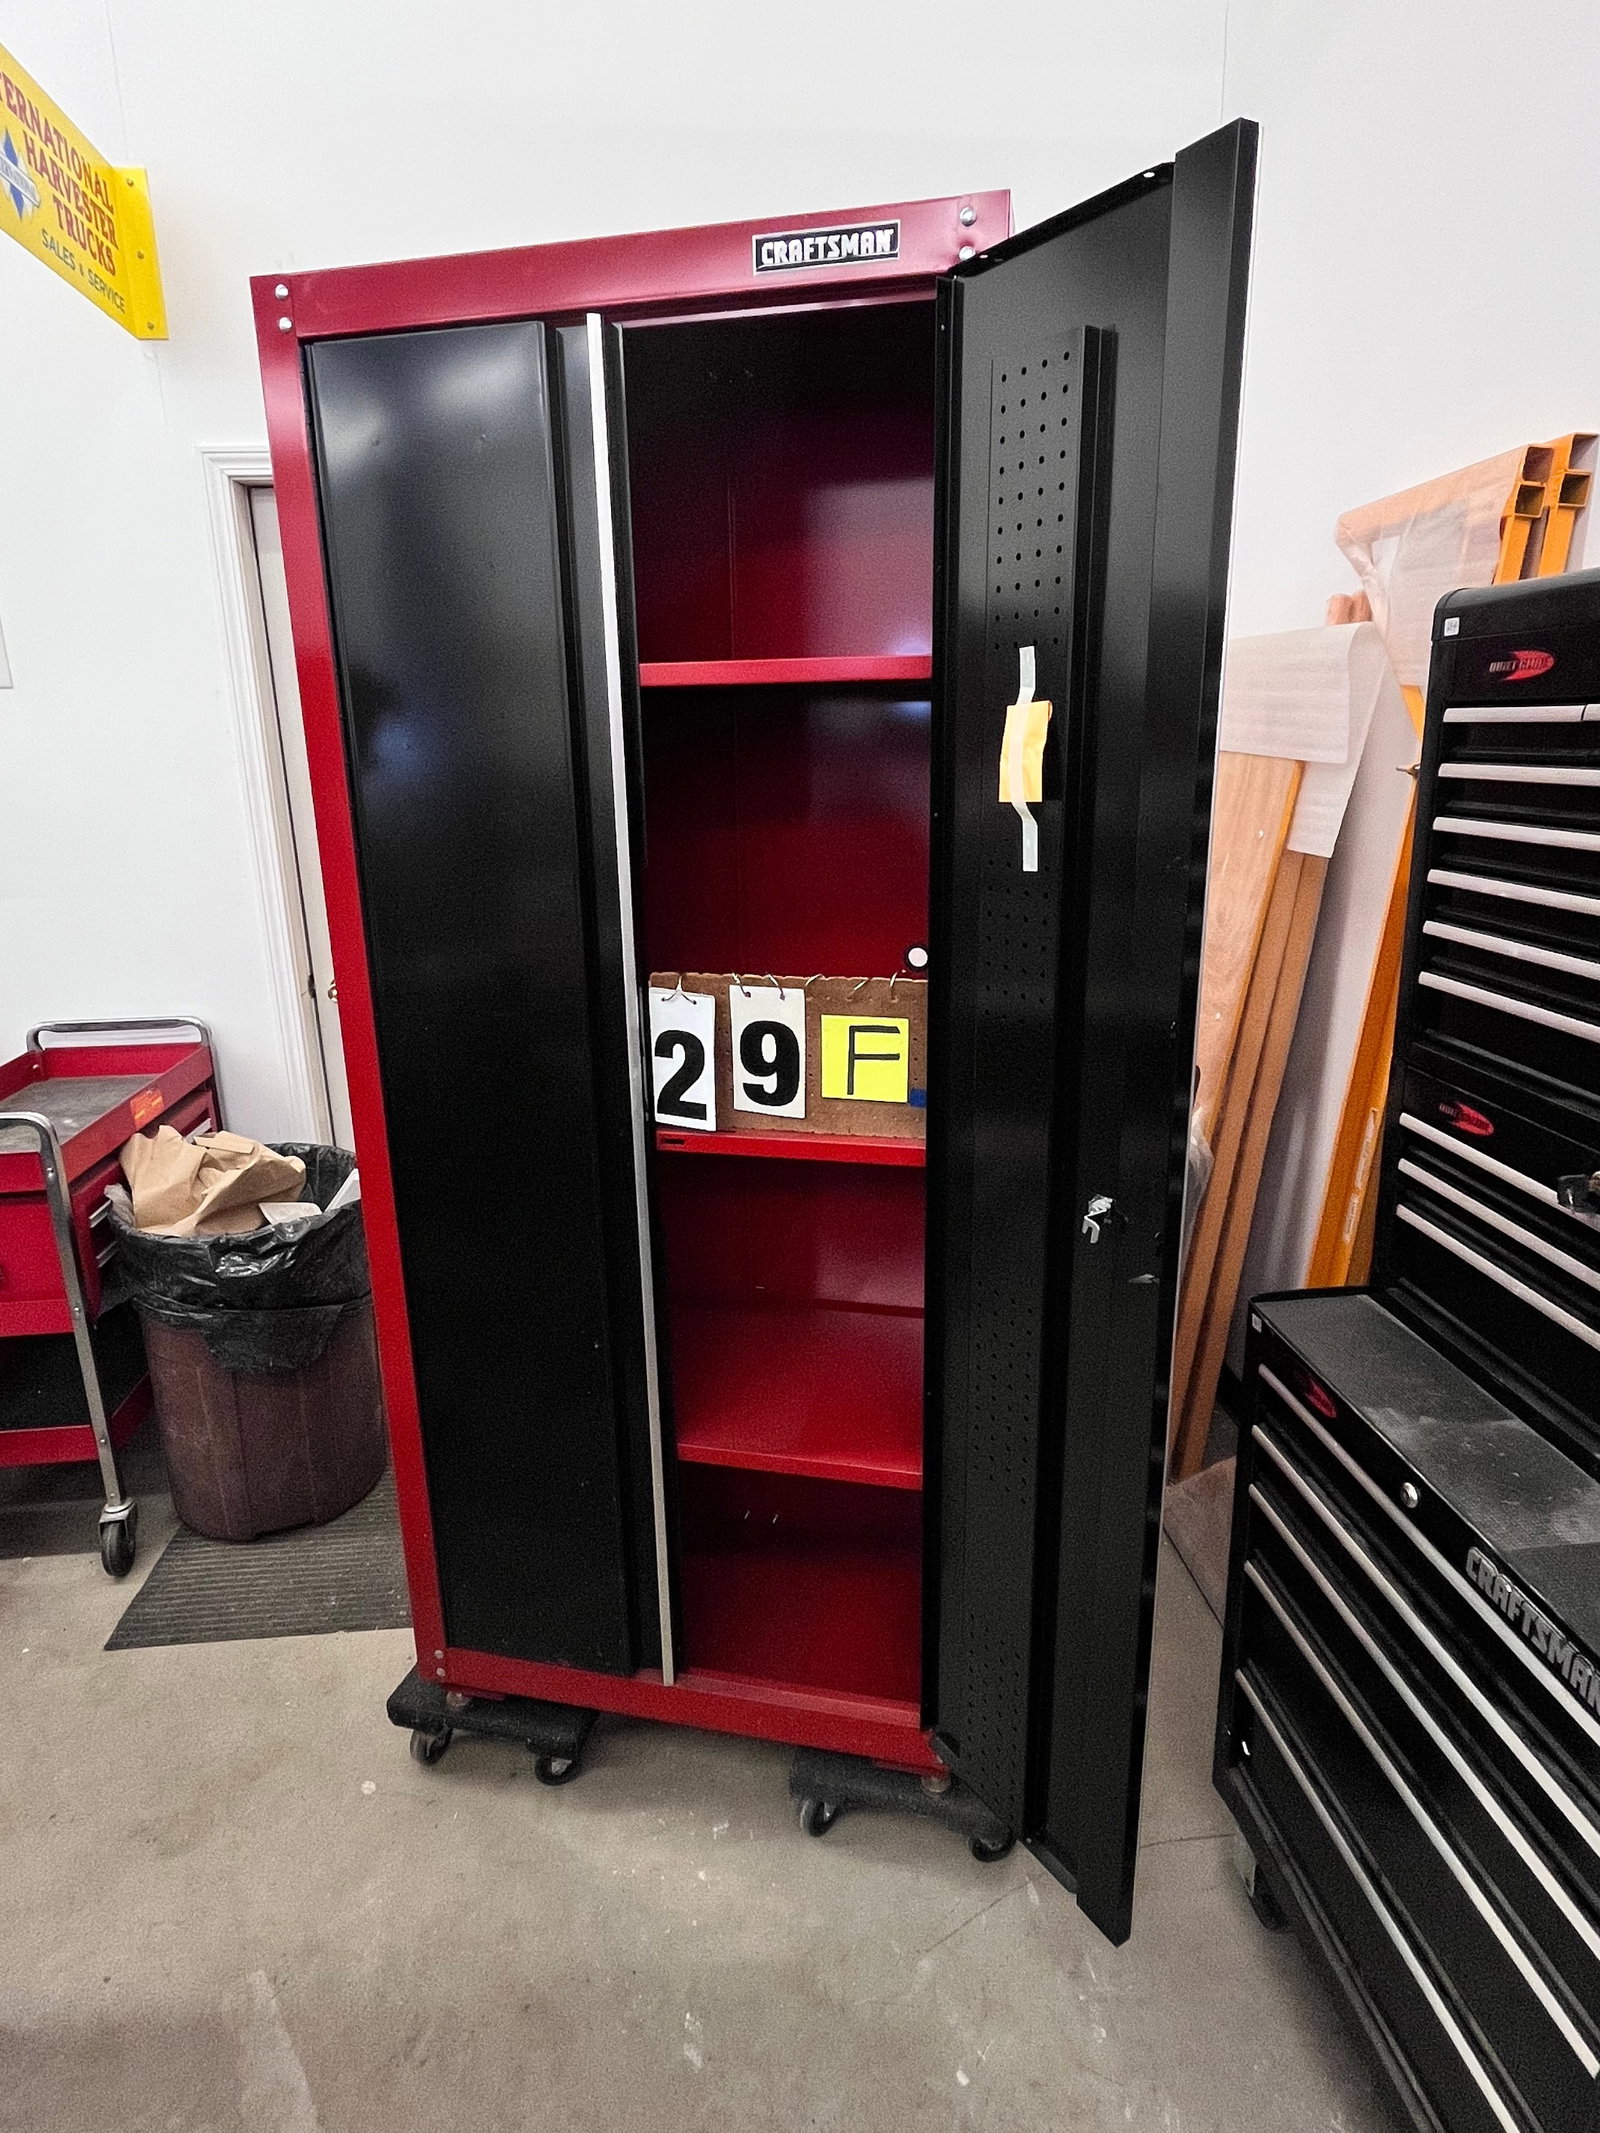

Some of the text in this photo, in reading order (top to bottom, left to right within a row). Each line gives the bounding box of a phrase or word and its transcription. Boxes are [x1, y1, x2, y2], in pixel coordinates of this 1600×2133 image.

[0, 71, 114, 215] ERNATIONAL
[23, 129, 119, 250] HARVESTER
[41, 228, 76, 271] SALES
[87, 267, 126, 314] SERVICE
[52, 194, 116, 277] TRUCKS
[761, 228, 894, 266] CRAFTSMAN
[654, 1020, 900, 1121] 2 9 F
